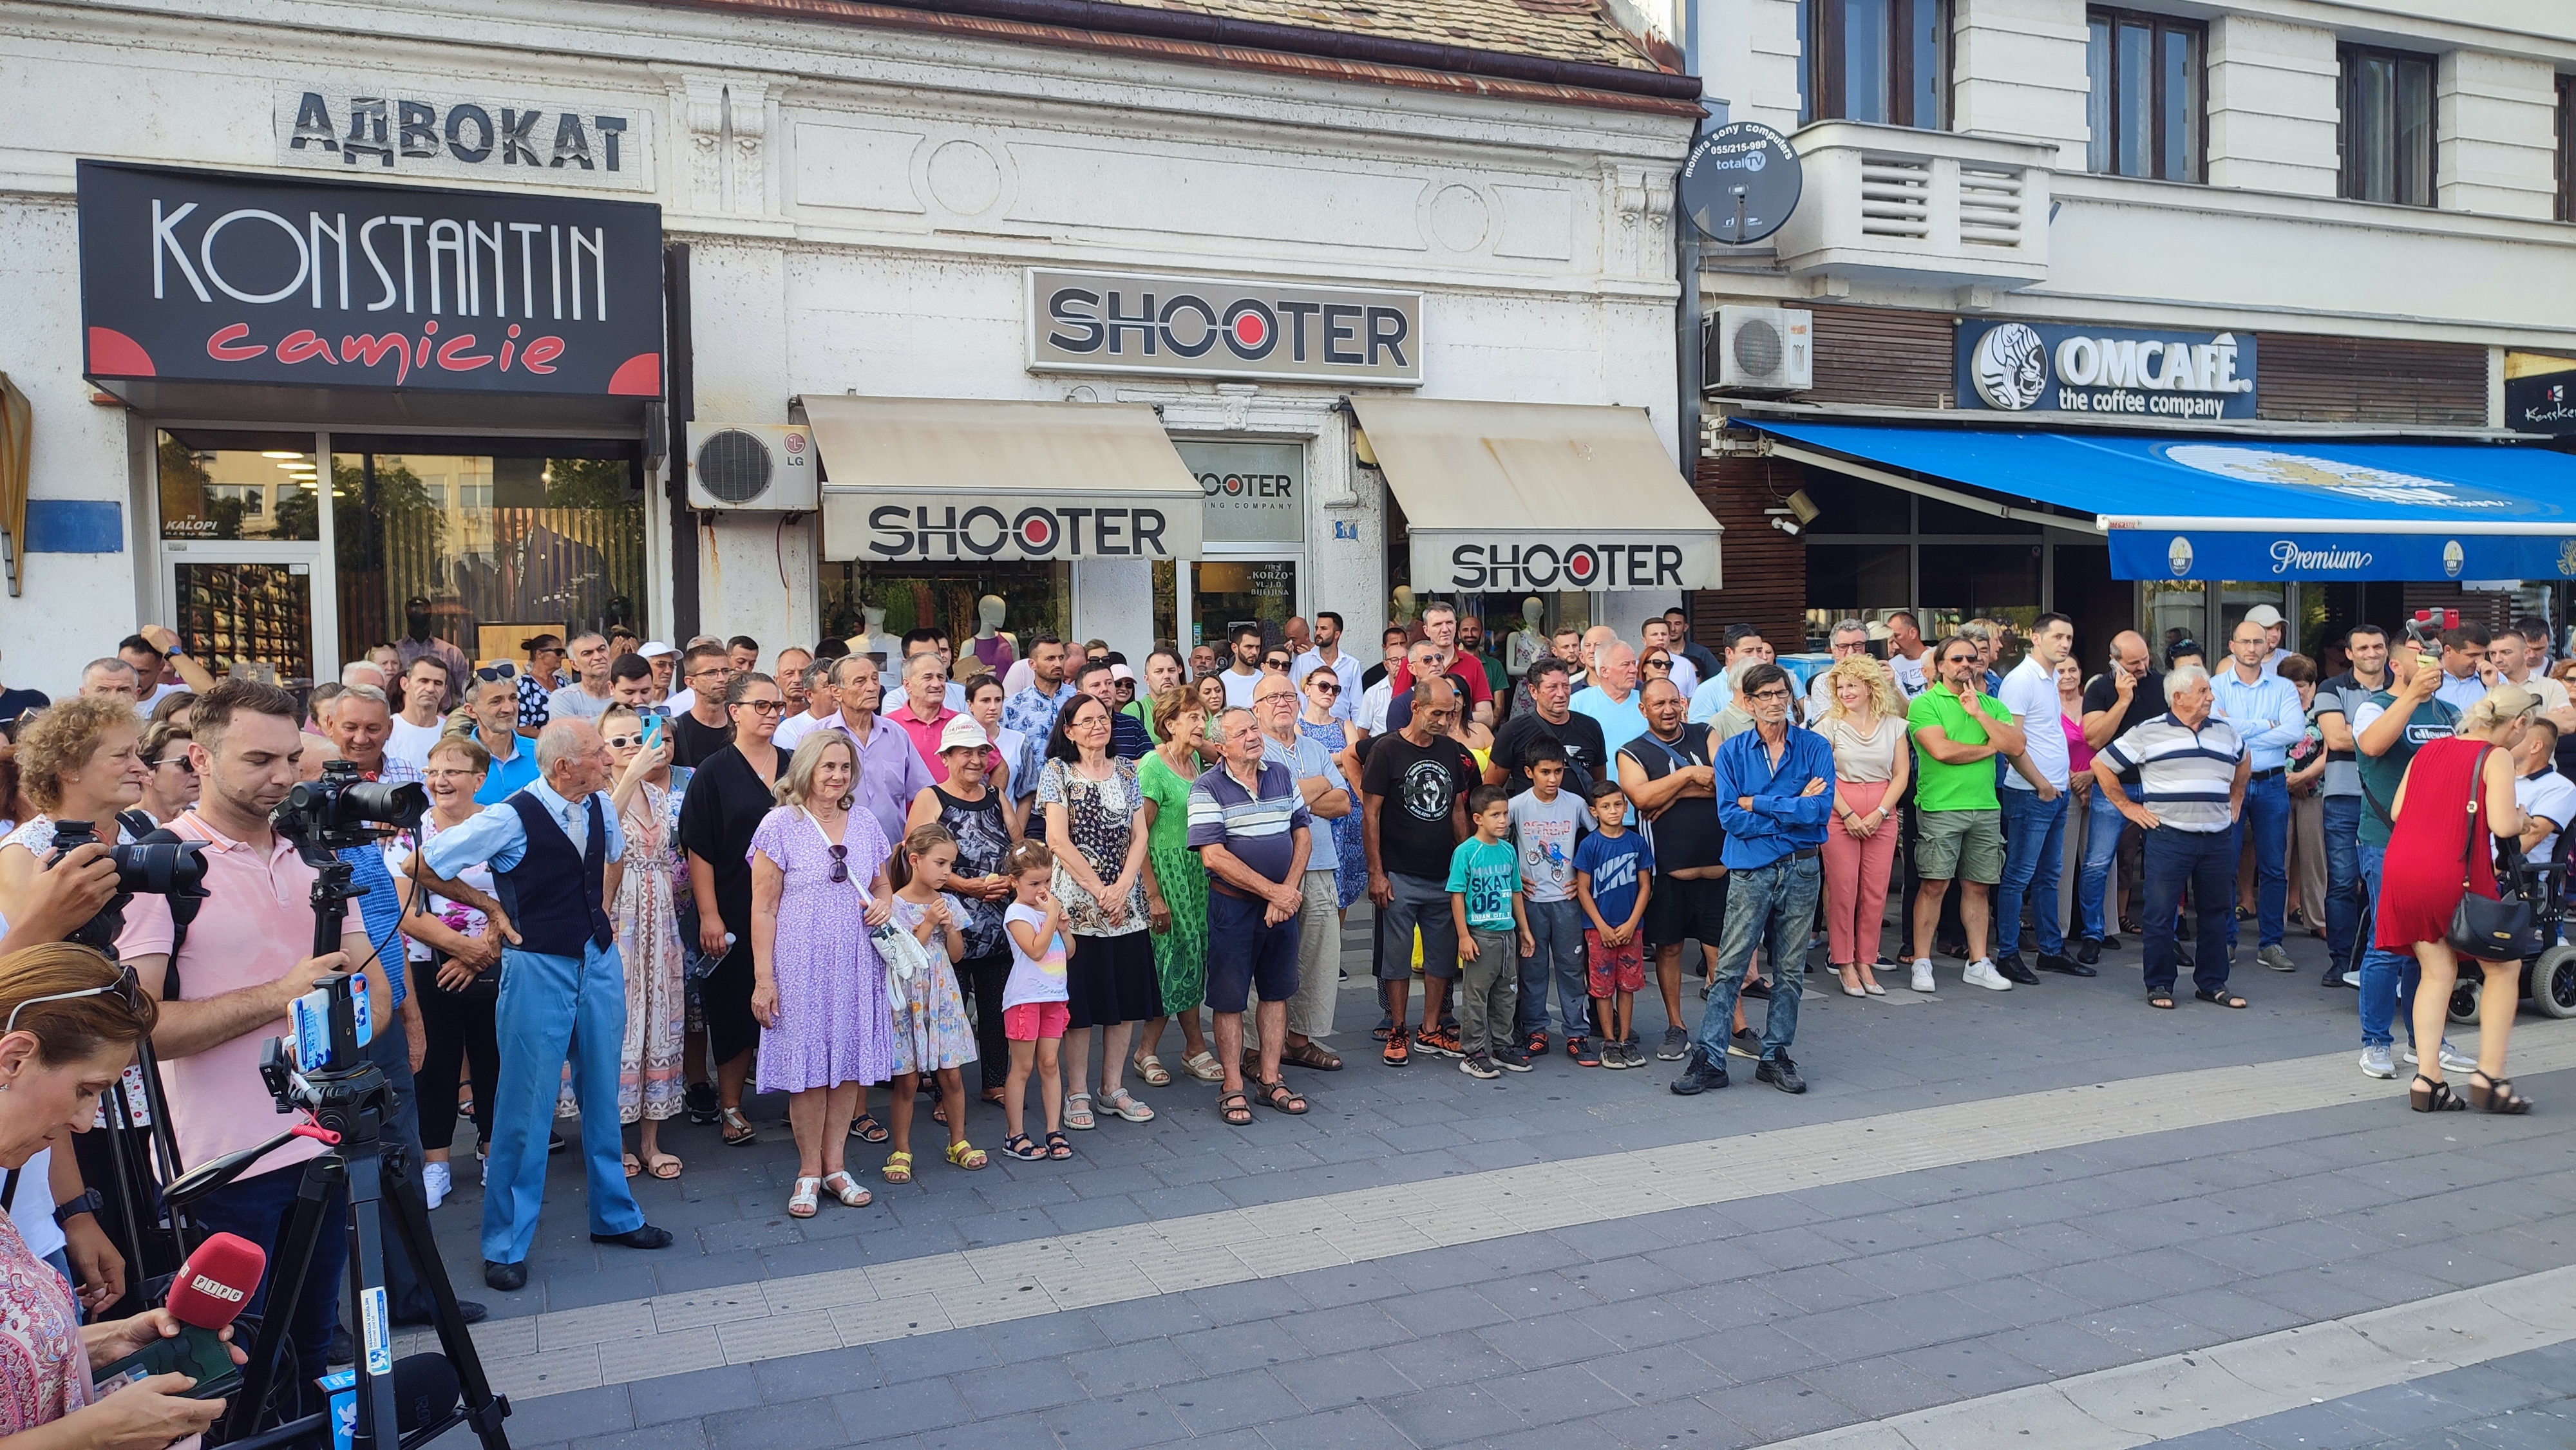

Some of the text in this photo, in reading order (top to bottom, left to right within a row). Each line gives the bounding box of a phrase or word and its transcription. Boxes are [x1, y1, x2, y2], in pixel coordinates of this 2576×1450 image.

[290, 91, 627, 171] АДВОКАТ
[1685, 124, 1793, 178] montira sony computers
[1711, 140, 1767, 155] 055/215-999
[151, 198, 607, 321] KONSTANTIN
[1047, 287, 1410, 368] SHOOTER
[206, 320, 566, 386] camicie
[2060, 388, 2225, 420] the coffee company
[787, 457, 804, 466] LG
[1193, 472, 1292, 498] OOTER
[166, 520, 218, 531] KALOPI
[869, 505, 1168, 557] SHOOTER
[1451, 543, 1684, 588] SHOOTER
[2270, 540, 2372, 574] Premium
[1593, 852, 1639, 899] NIKE
[1472, 891, 1501, 914] 06
